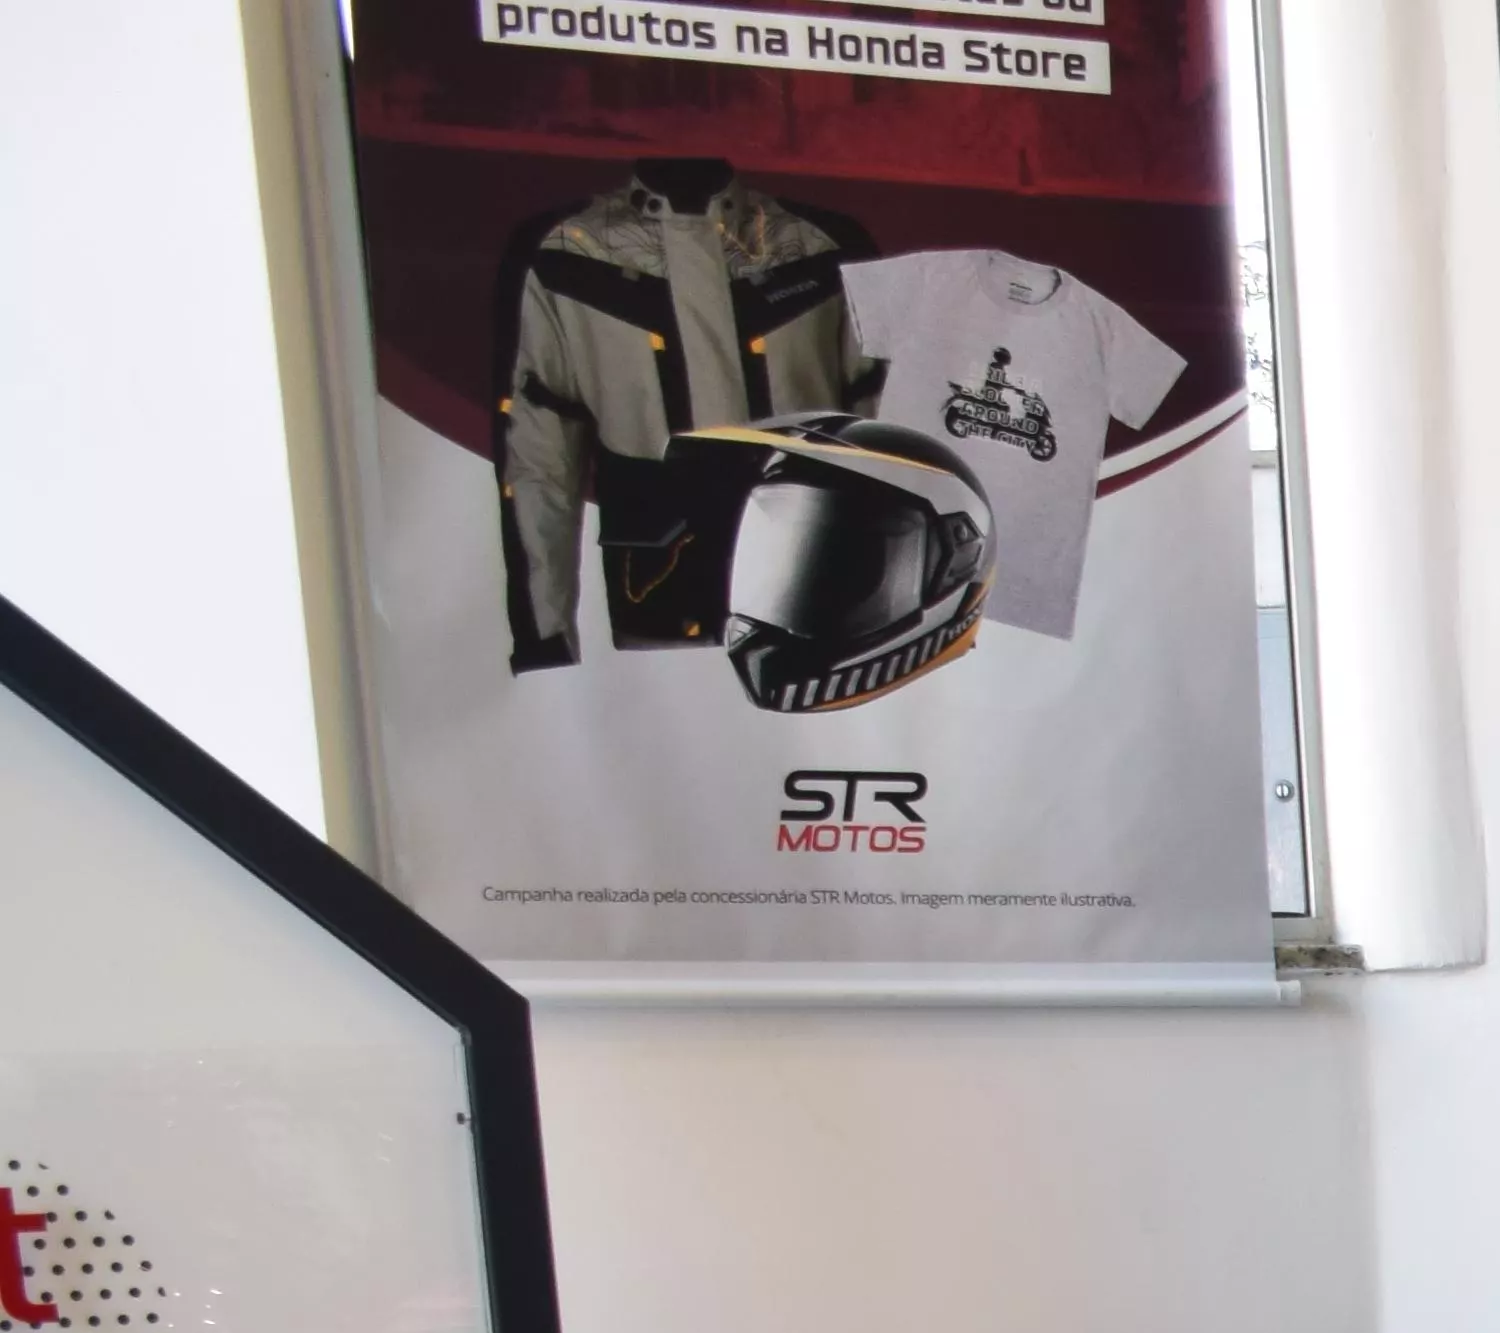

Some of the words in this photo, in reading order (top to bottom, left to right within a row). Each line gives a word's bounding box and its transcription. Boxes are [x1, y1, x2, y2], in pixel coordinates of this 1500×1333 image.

[497, 3, 717, 50] produtos
[736, 24, 790, 57] na
[807, 25, 946, 70] Honda
[962, 39, 1088, 82] Store
[780, 769, 928, 823] STR
[776, 824, 927, 853] MOTOS
[482, 886, 573, 904] Campanha
[577, 887, 650, 903] realizada
[653, 887, 687, 906] pela
[690, 888, 808, 905] concessionária
[810, 889, 841, 905] STR
[844, 890, 897, 906] Motos.
[901, 891, 965, 909] Imagem
[968, 892, 1057, 907] meramente
[1060, 891, 1136, 908] ilustrativa.
